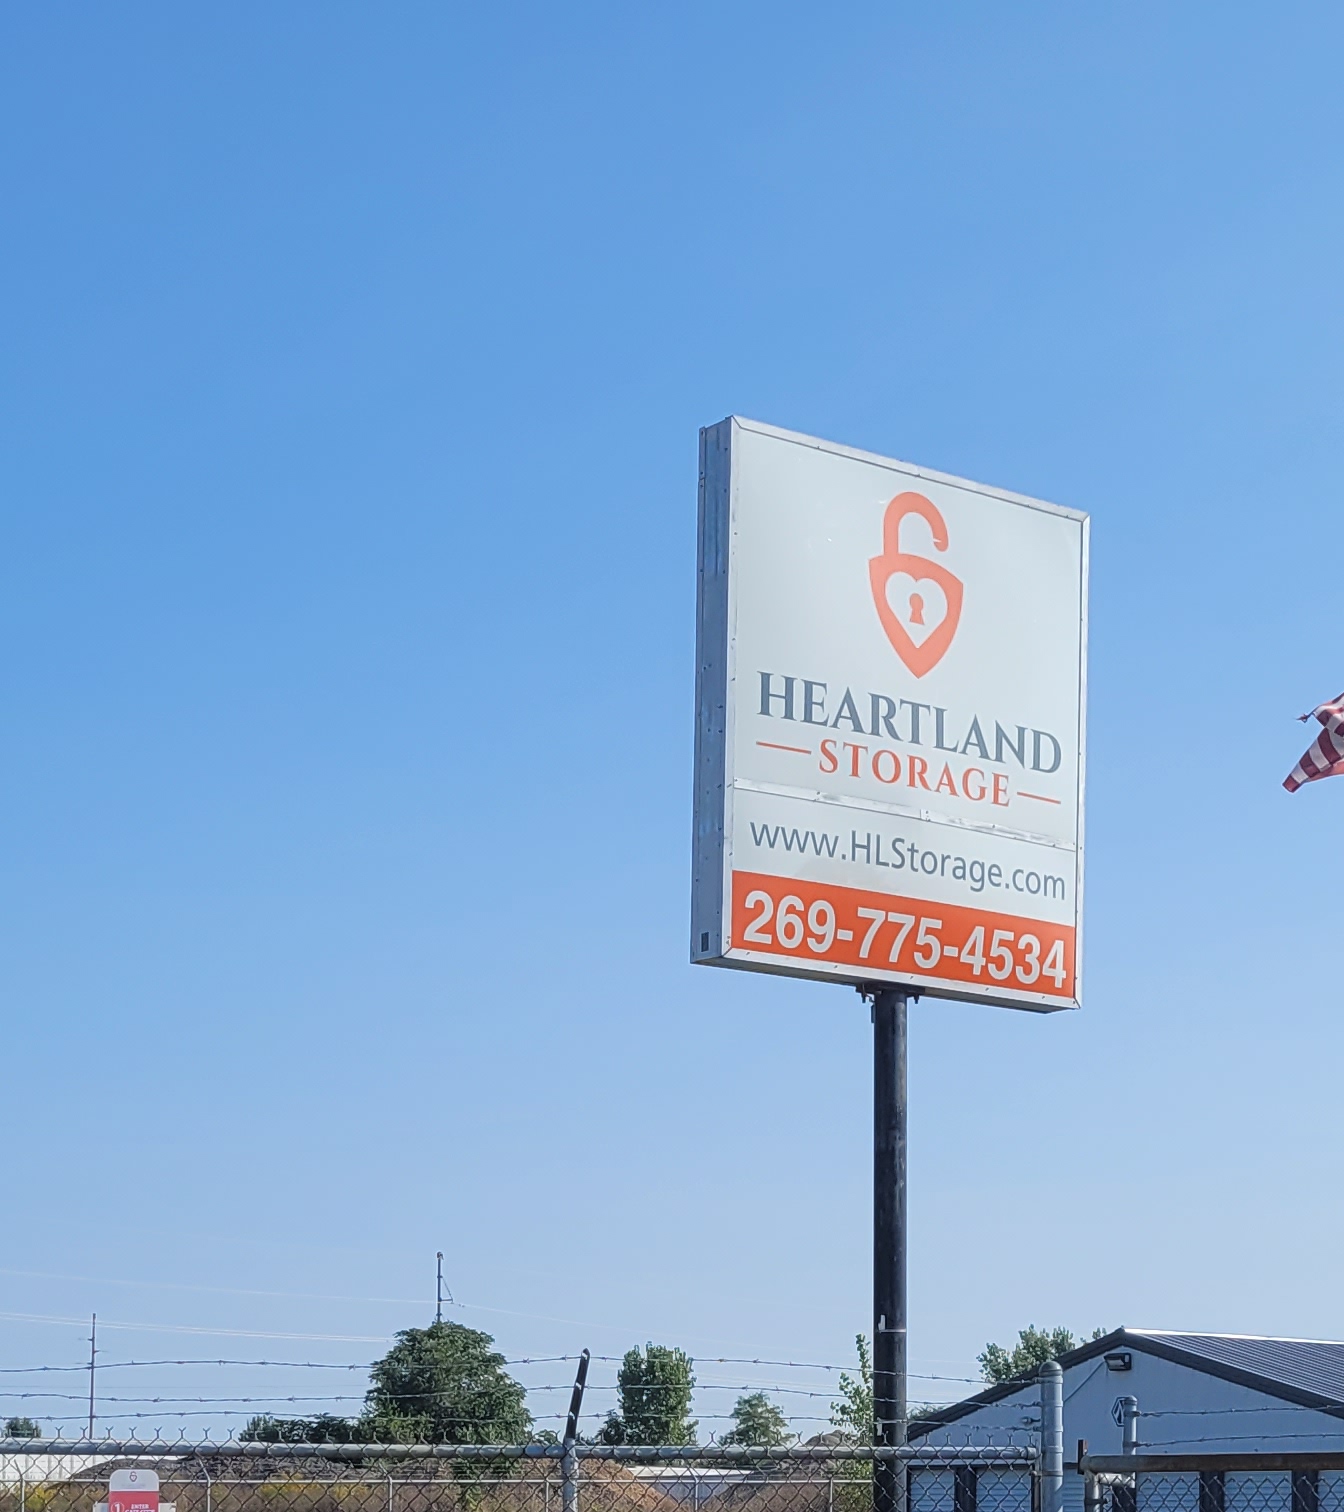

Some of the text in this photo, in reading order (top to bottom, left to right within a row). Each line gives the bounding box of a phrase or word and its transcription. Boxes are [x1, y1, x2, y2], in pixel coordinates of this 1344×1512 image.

[757, 671, 1062, 774] HEARTLAND
[819, 739, 1010, 807] STORAGE
[750, 821, 1066, 900] www.HLStorage.com
[744, 890, 1066, 989] 269-775-4534
